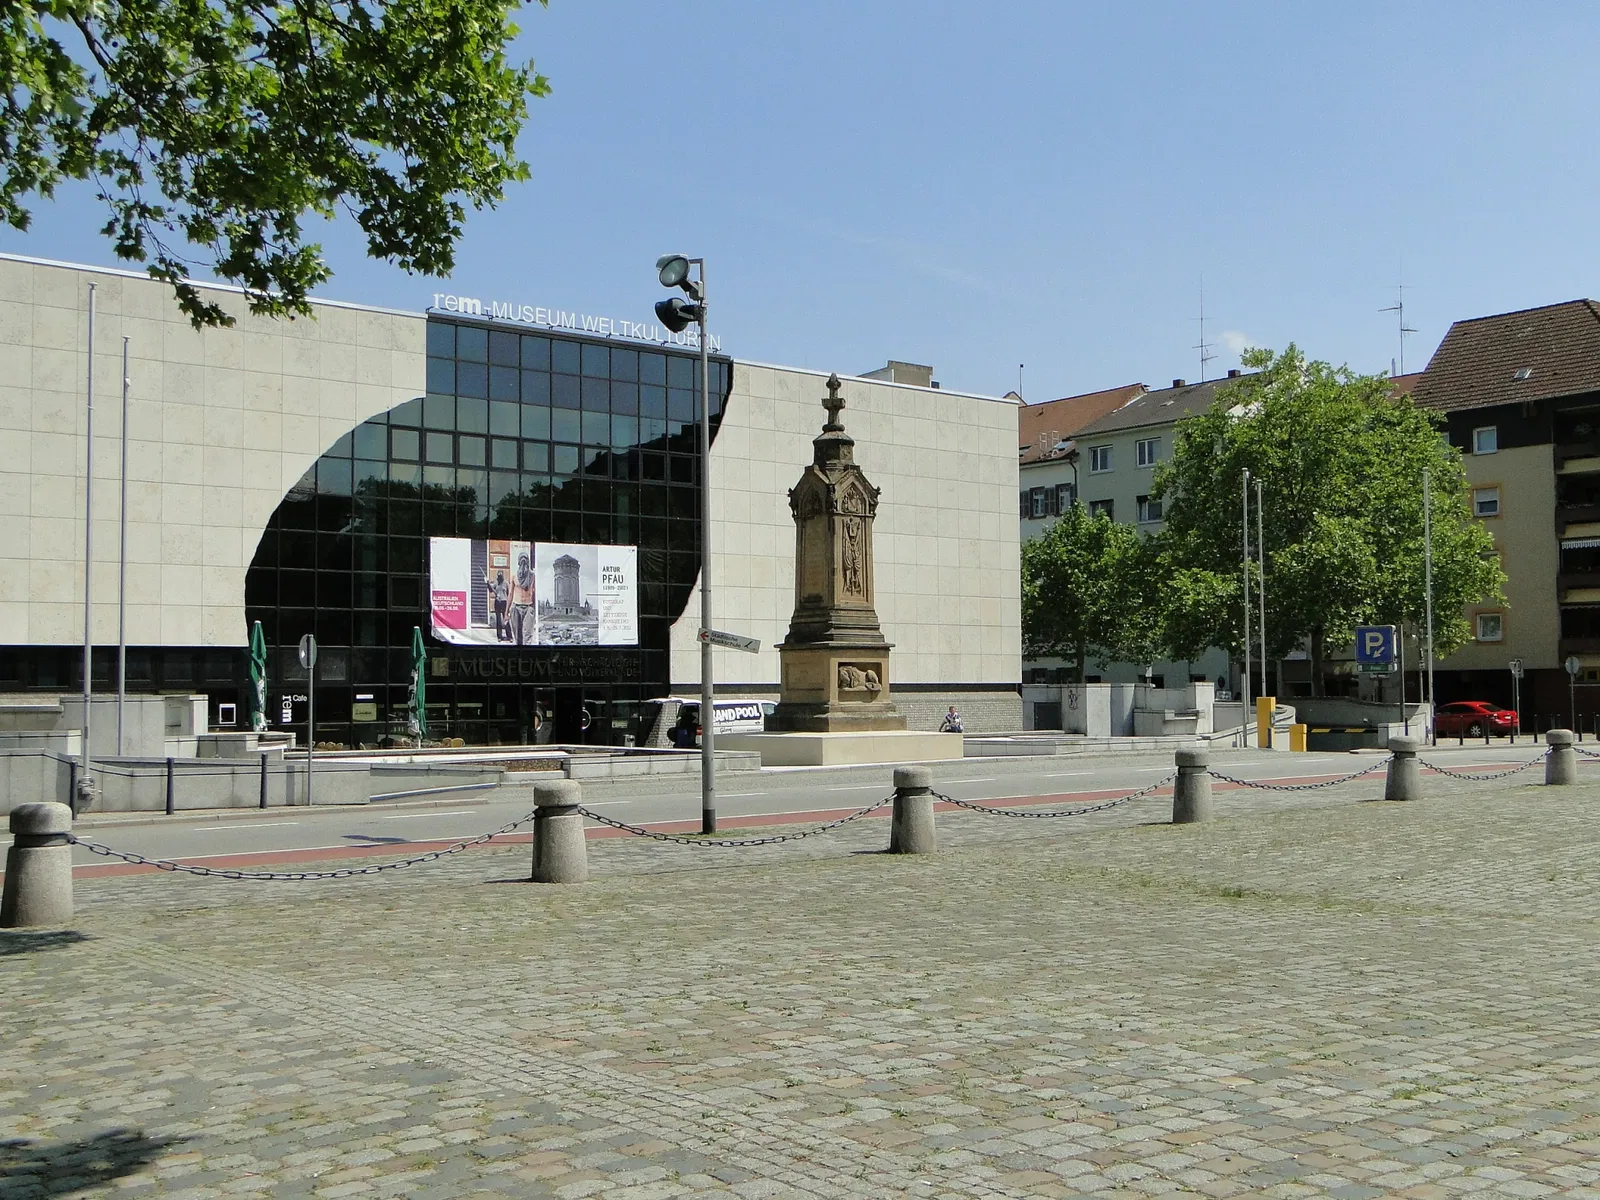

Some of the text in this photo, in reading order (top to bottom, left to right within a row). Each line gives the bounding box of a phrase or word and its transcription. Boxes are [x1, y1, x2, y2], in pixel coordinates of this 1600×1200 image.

[602, 565, 621, 573] ARTUR
[602, 573, 624, 584] PFAU
[709, 637, 742, 648] Musikschule
[1366, 632, 1383, 655] P
[457, 657, 552, 677] MUSEUM
[282, 695, 292, 723] rem
